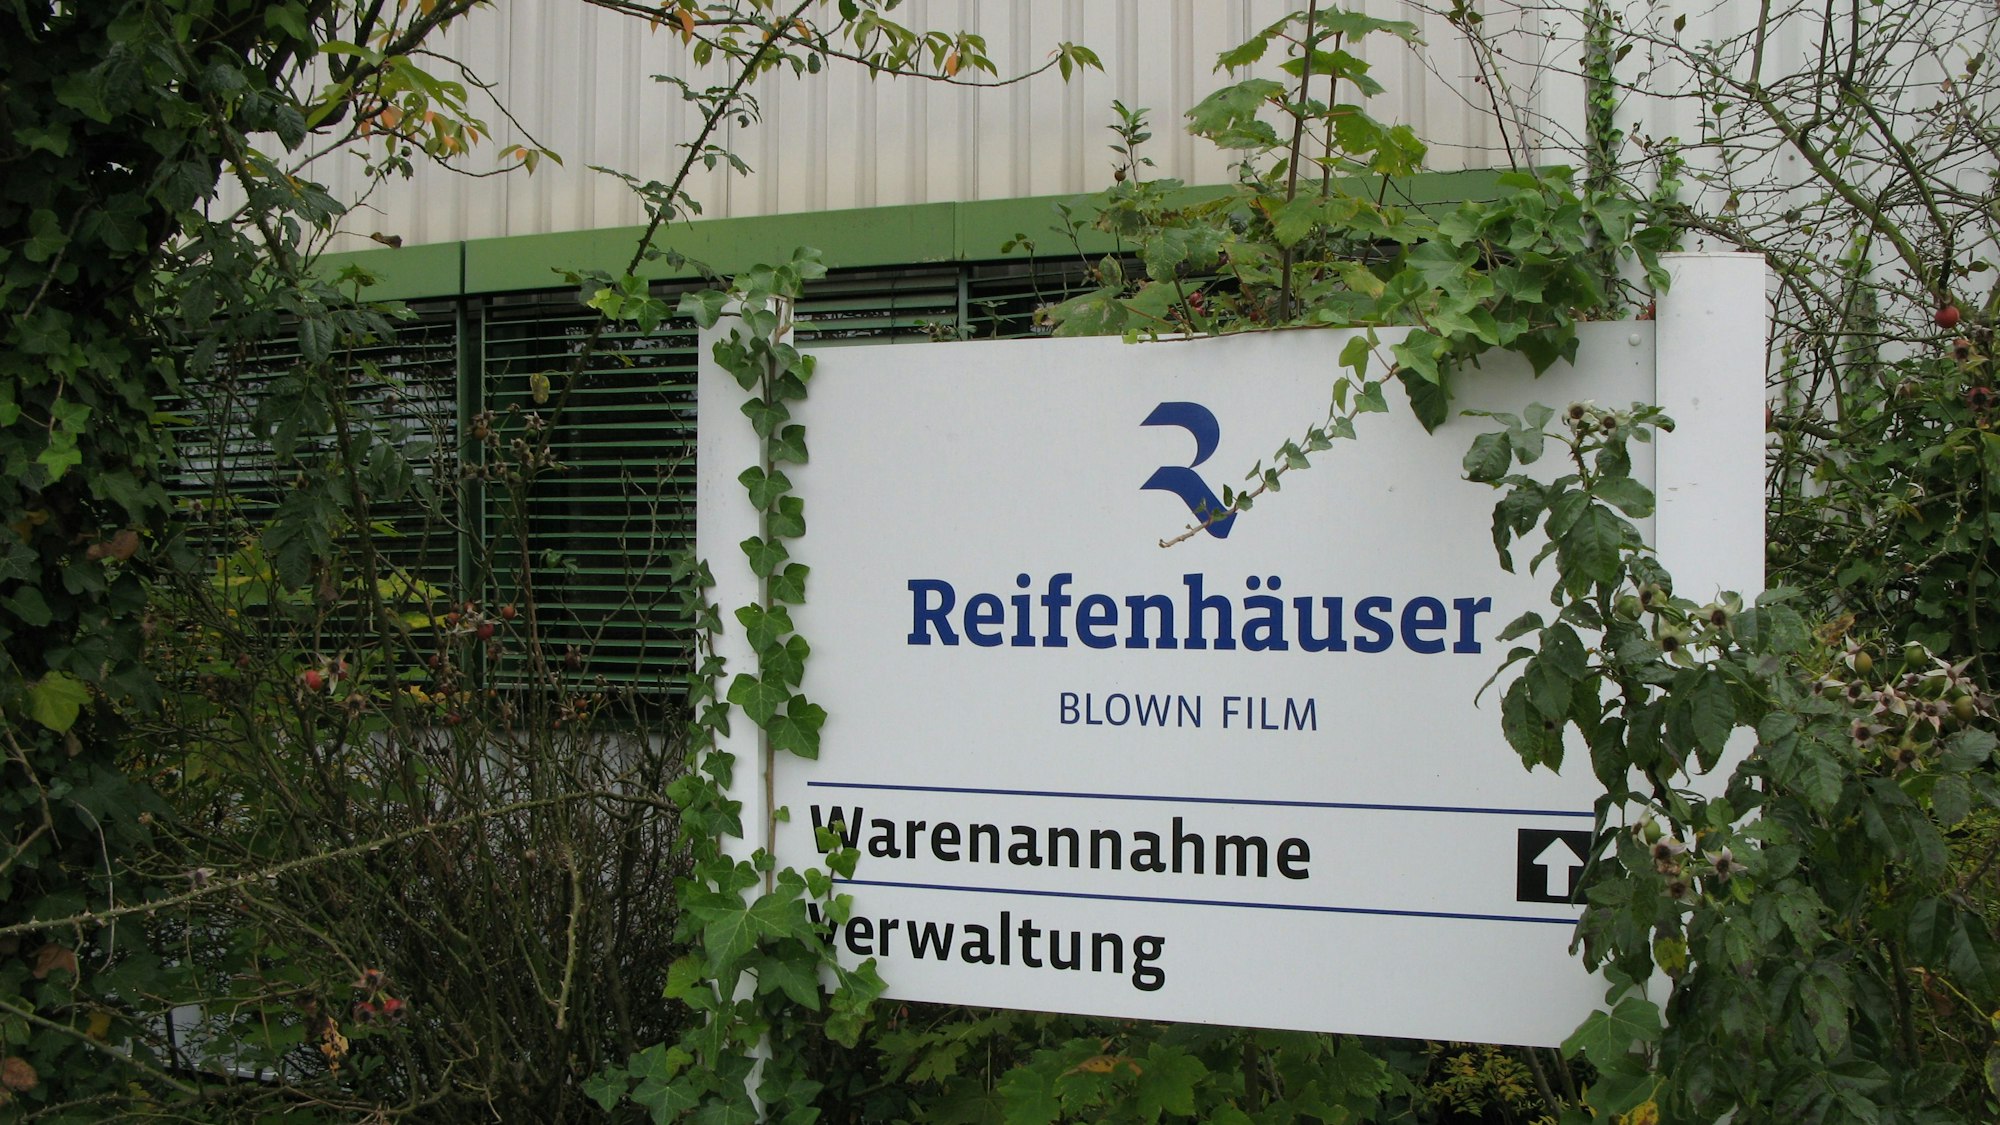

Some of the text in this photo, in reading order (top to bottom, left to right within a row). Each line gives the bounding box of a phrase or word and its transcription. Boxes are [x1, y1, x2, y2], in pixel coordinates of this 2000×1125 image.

[906, 572, 1492, 655] Reifenhäuser
[1060, 692, 1318, 732] BLOWN FILM
[810, 804, 1311, 880] Warenannahme
